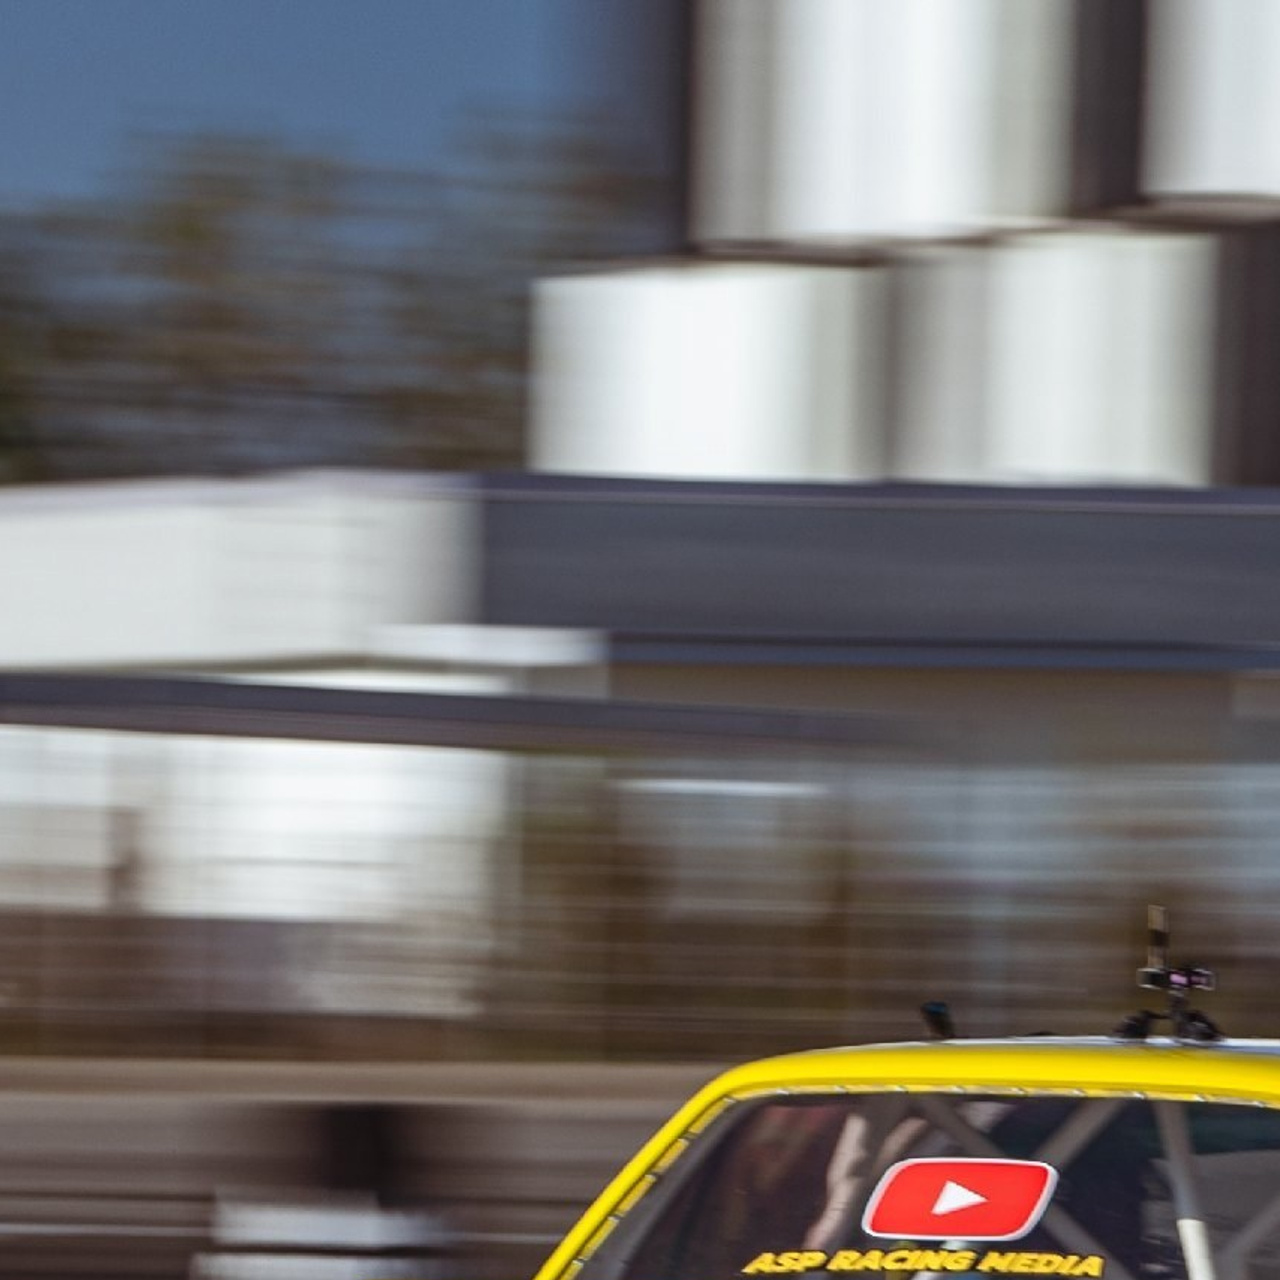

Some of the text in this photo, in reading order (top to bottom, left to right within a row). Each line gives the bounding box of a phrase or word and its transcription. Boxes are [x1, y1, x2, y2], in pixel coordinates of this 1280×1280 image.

[744, 1251, 1104, 1277] ASP RACING MEDIA
